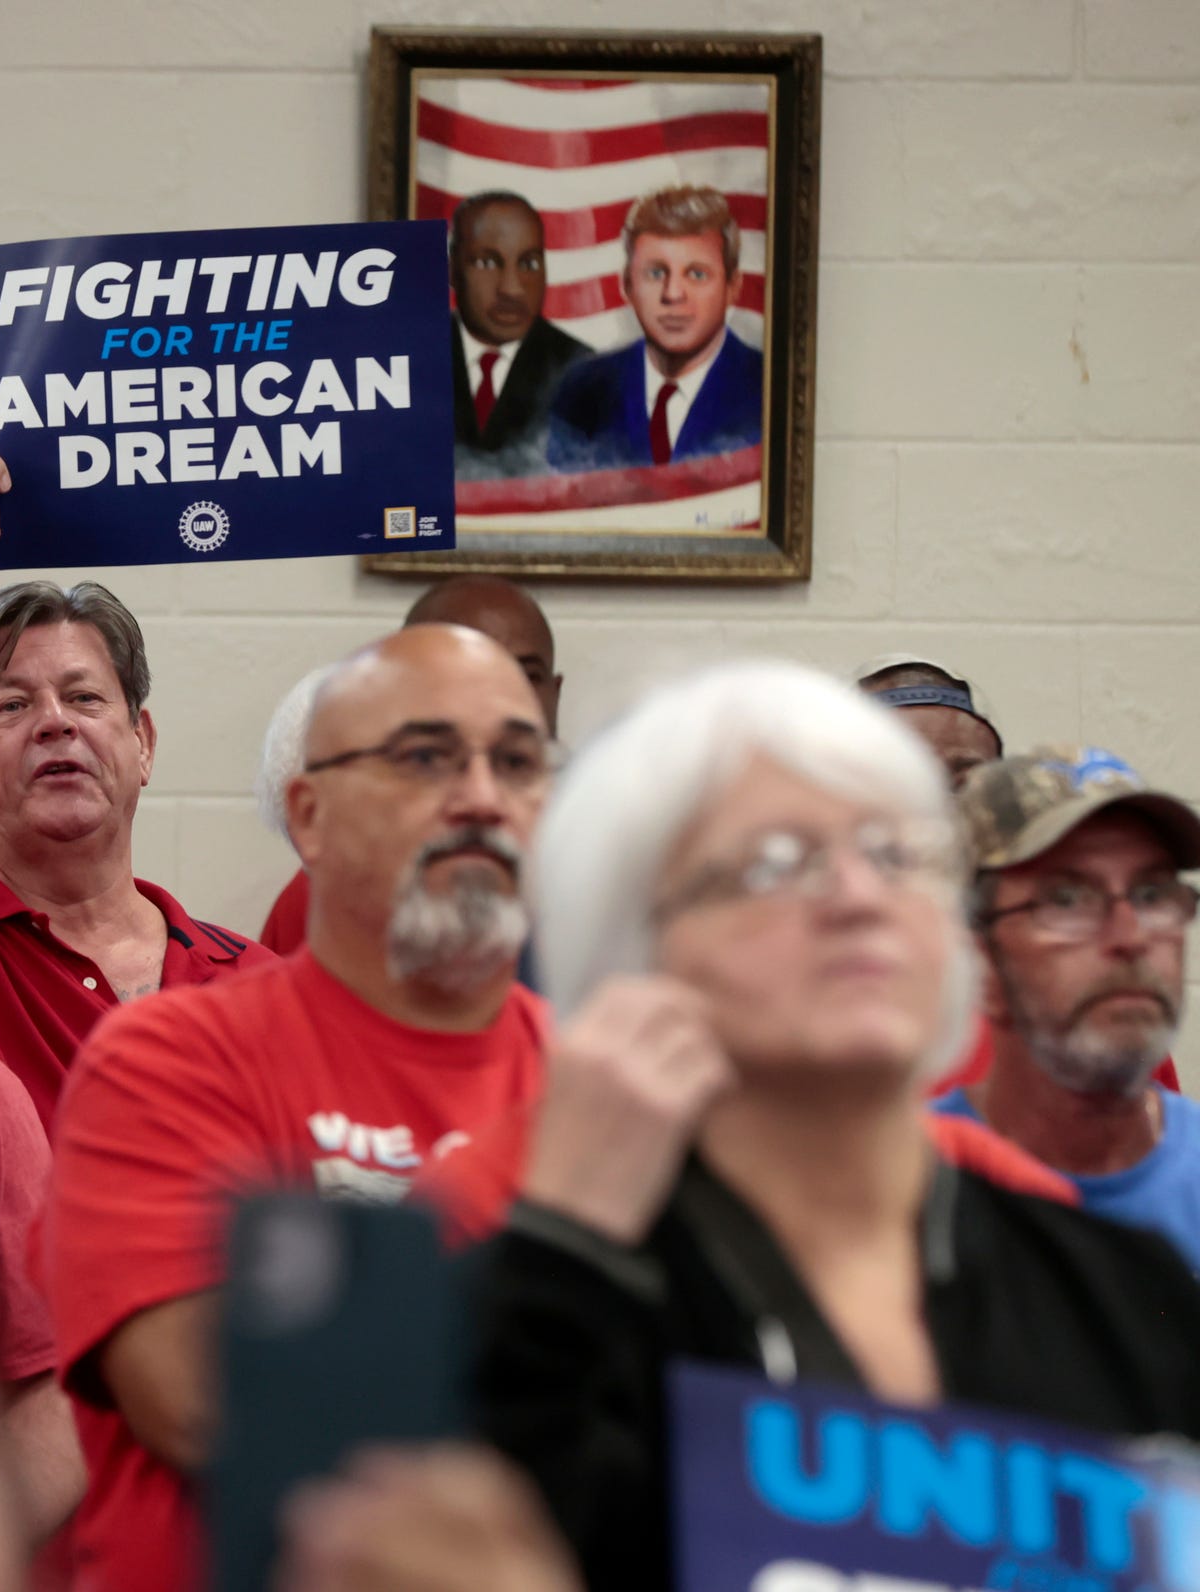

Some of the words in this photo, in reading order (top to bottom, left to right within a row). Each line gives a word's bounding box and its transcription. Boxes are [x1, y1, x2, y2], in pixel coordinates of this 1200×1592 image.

[100, 325, 193, 360] FOR
[209, 319, 293, 354] THE
[58, 421, 342, 490] DREAM
[193, 521, 215, 533] UAW
[418, 516, 438, 524] JOIN
[418, 529, 443, 537] FIGHT
[747, 1399, 1190, 1576] UNIT
